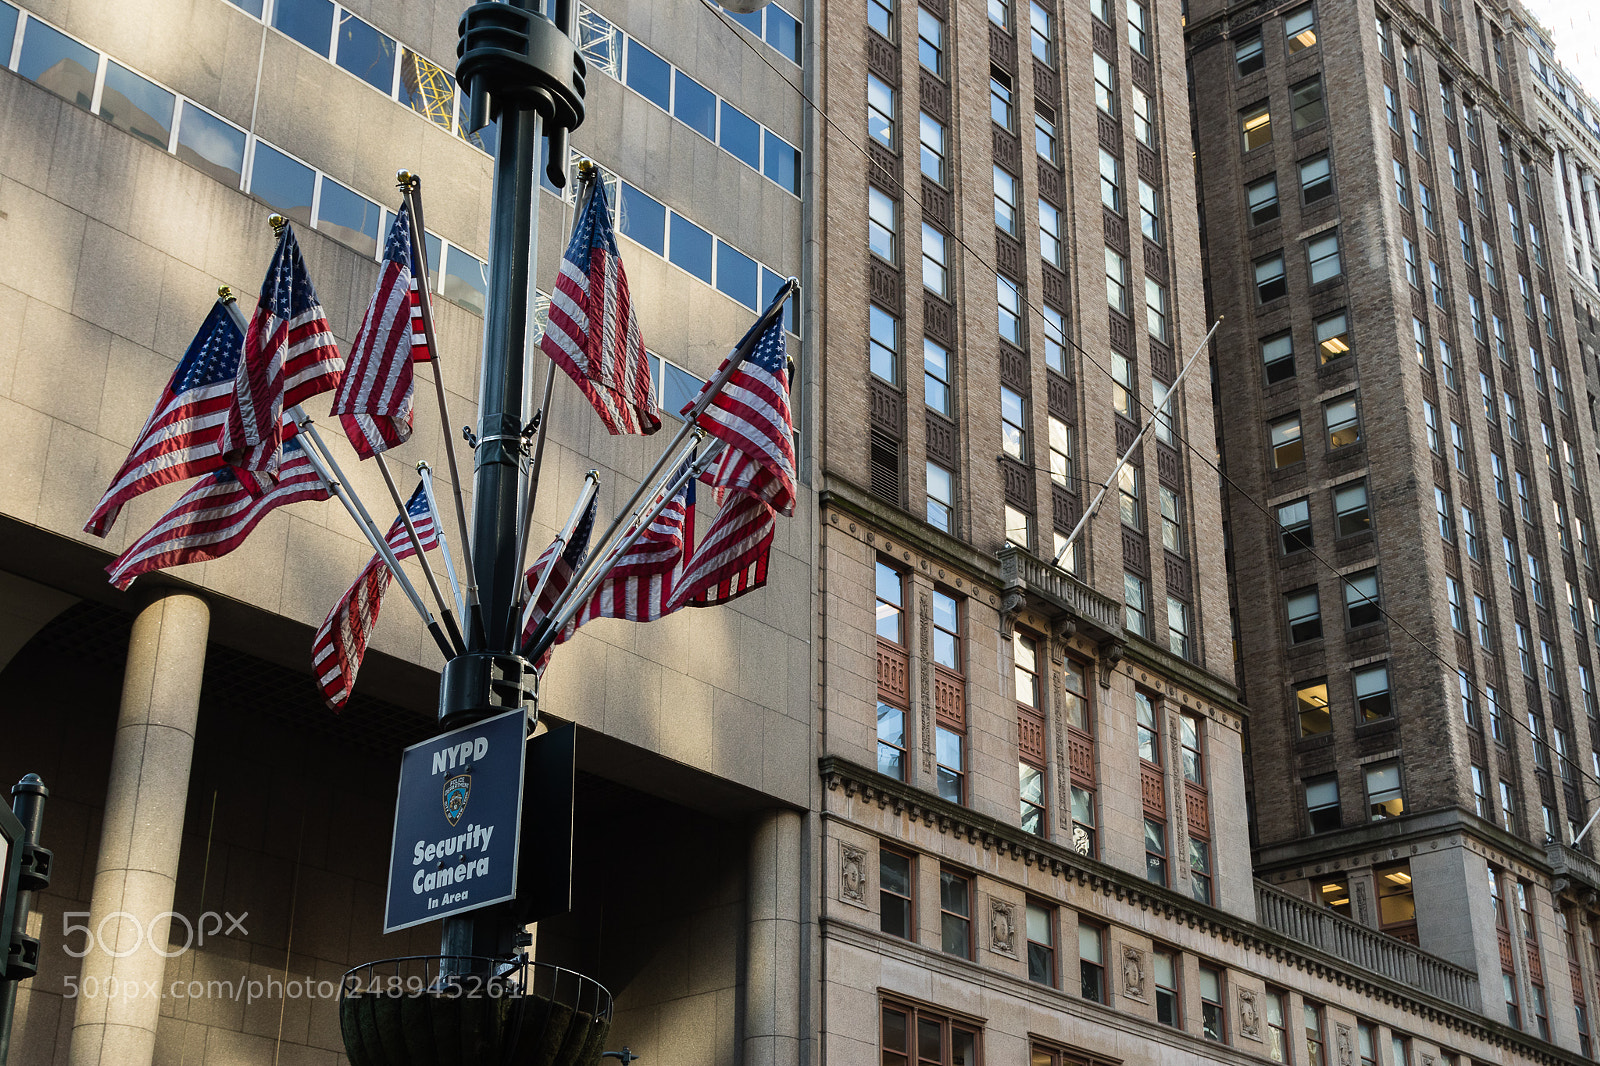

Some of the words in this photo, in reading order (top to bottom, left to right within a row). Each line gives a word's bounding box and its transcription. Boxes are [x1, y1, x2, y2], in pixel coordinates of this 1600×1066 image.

[432, 737, 488, 775] NYPD
[412, 823, 494, 866] Security
[412, 857, 490, 895] Camera
[427, 897, 439, 910] In
[441, 890, 469, 904] Area
